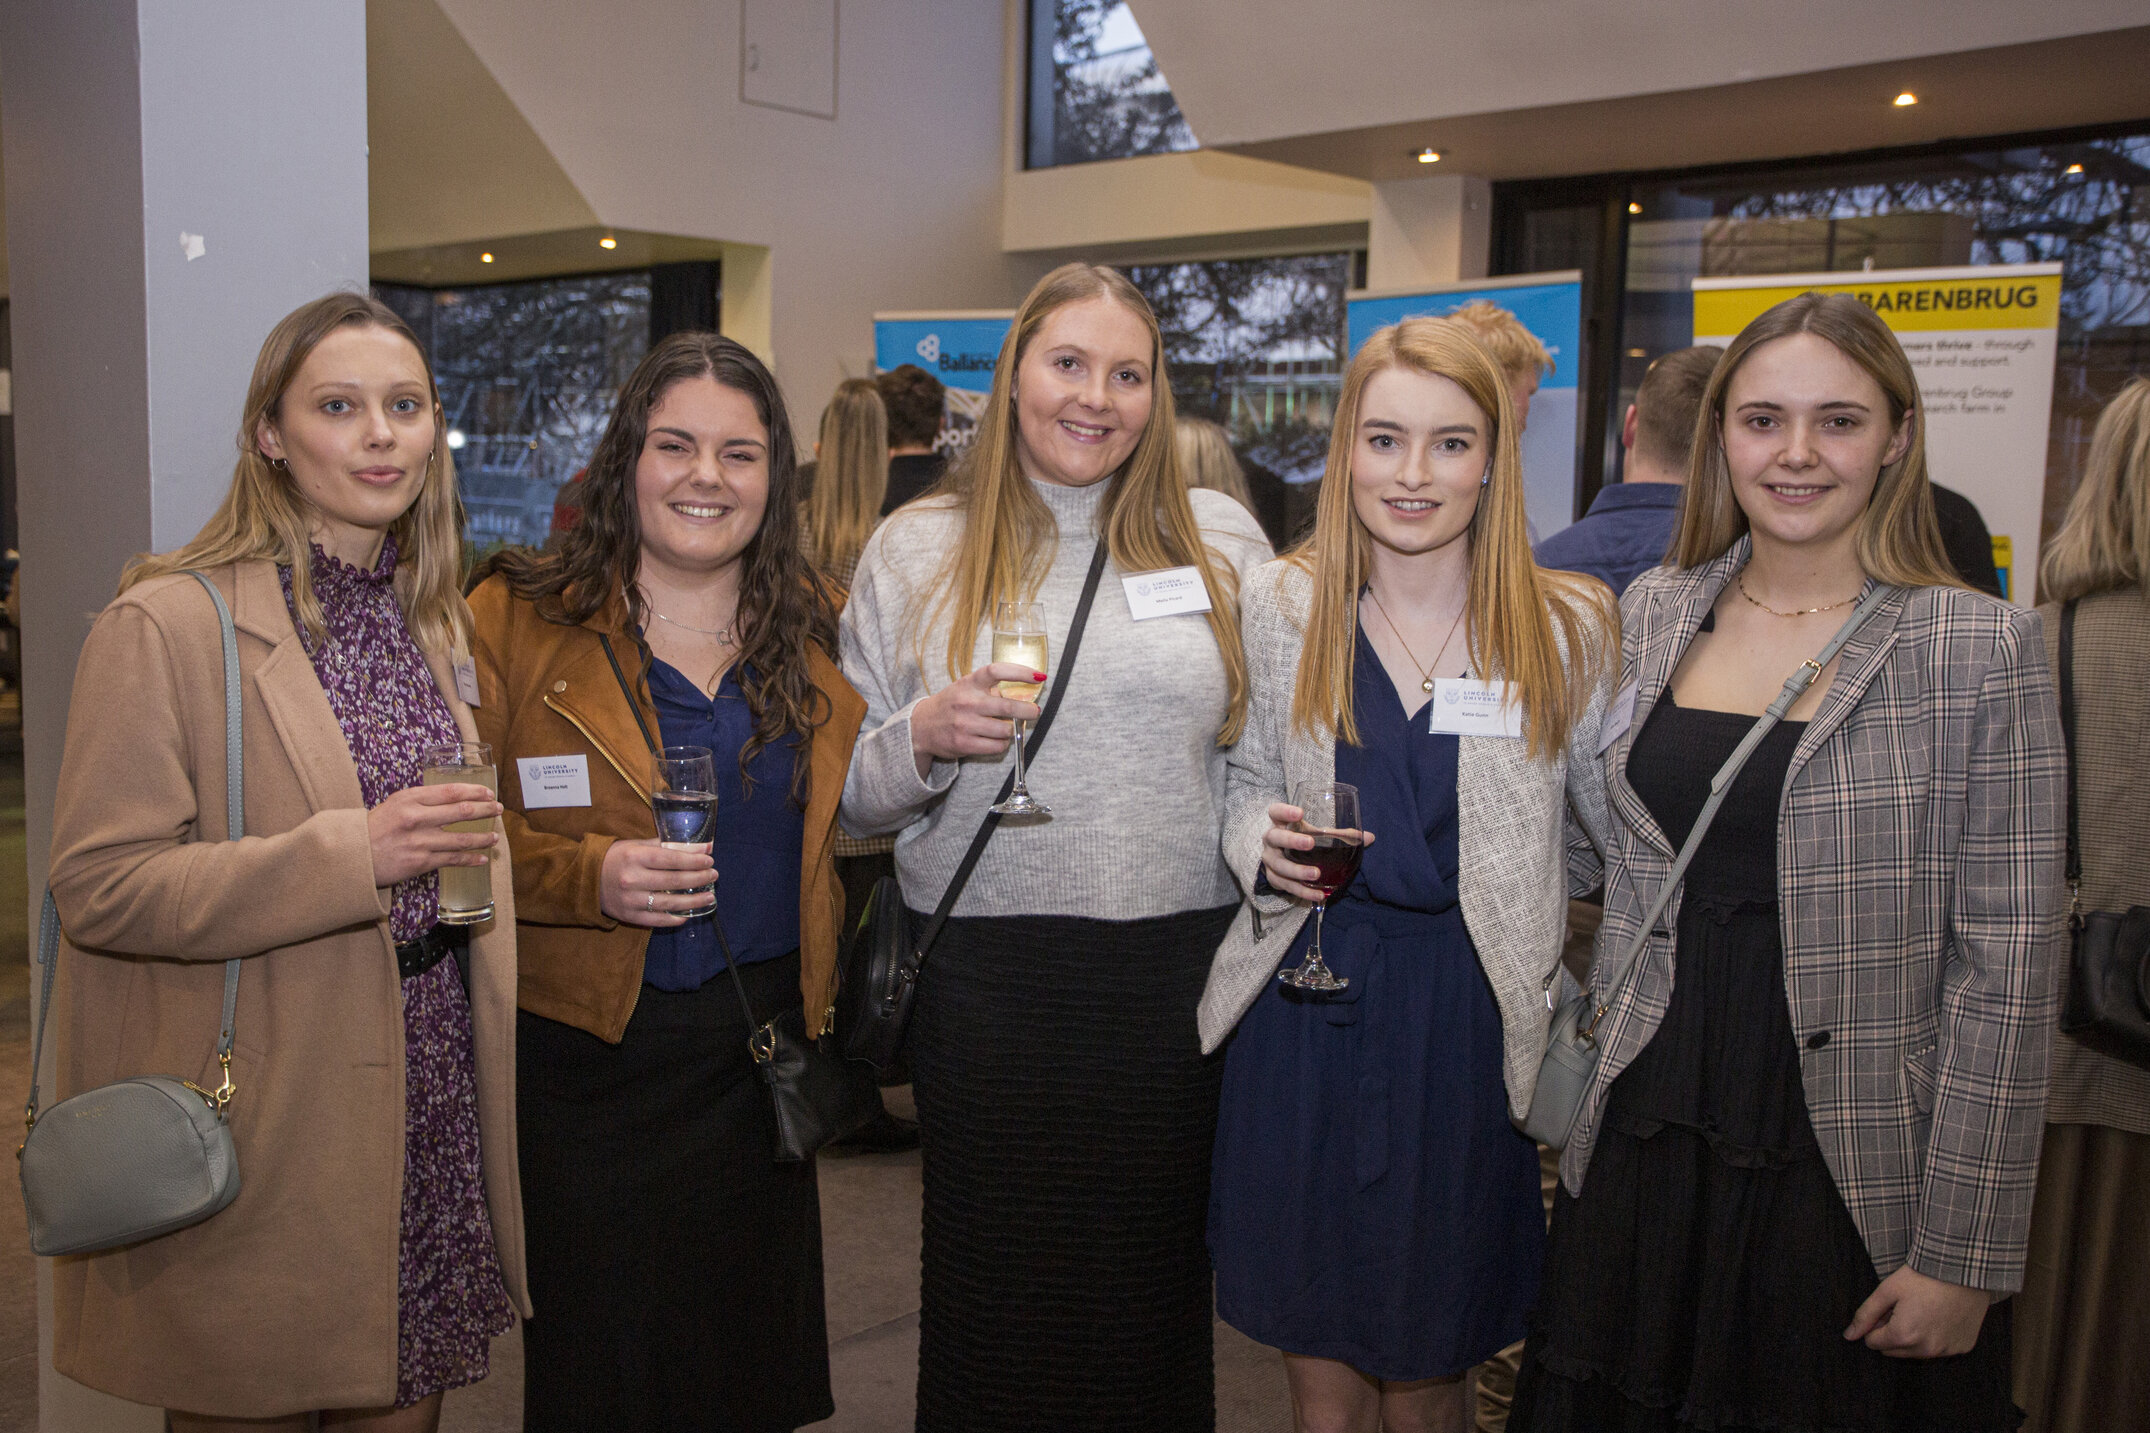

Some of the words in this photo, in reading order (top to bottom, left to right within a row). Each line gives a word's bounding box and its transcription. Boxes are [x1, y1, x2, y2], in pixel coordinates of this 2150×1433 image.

[1858, 286, 2037, 312] BARENBRUG
[1983, 339, 2034, 353] through
[1971, 386, 2014, 401] Group
[1152, 579, 1181, 587] LINCOLN
[1154, 581, 1193, 590] UNIVERSITY
